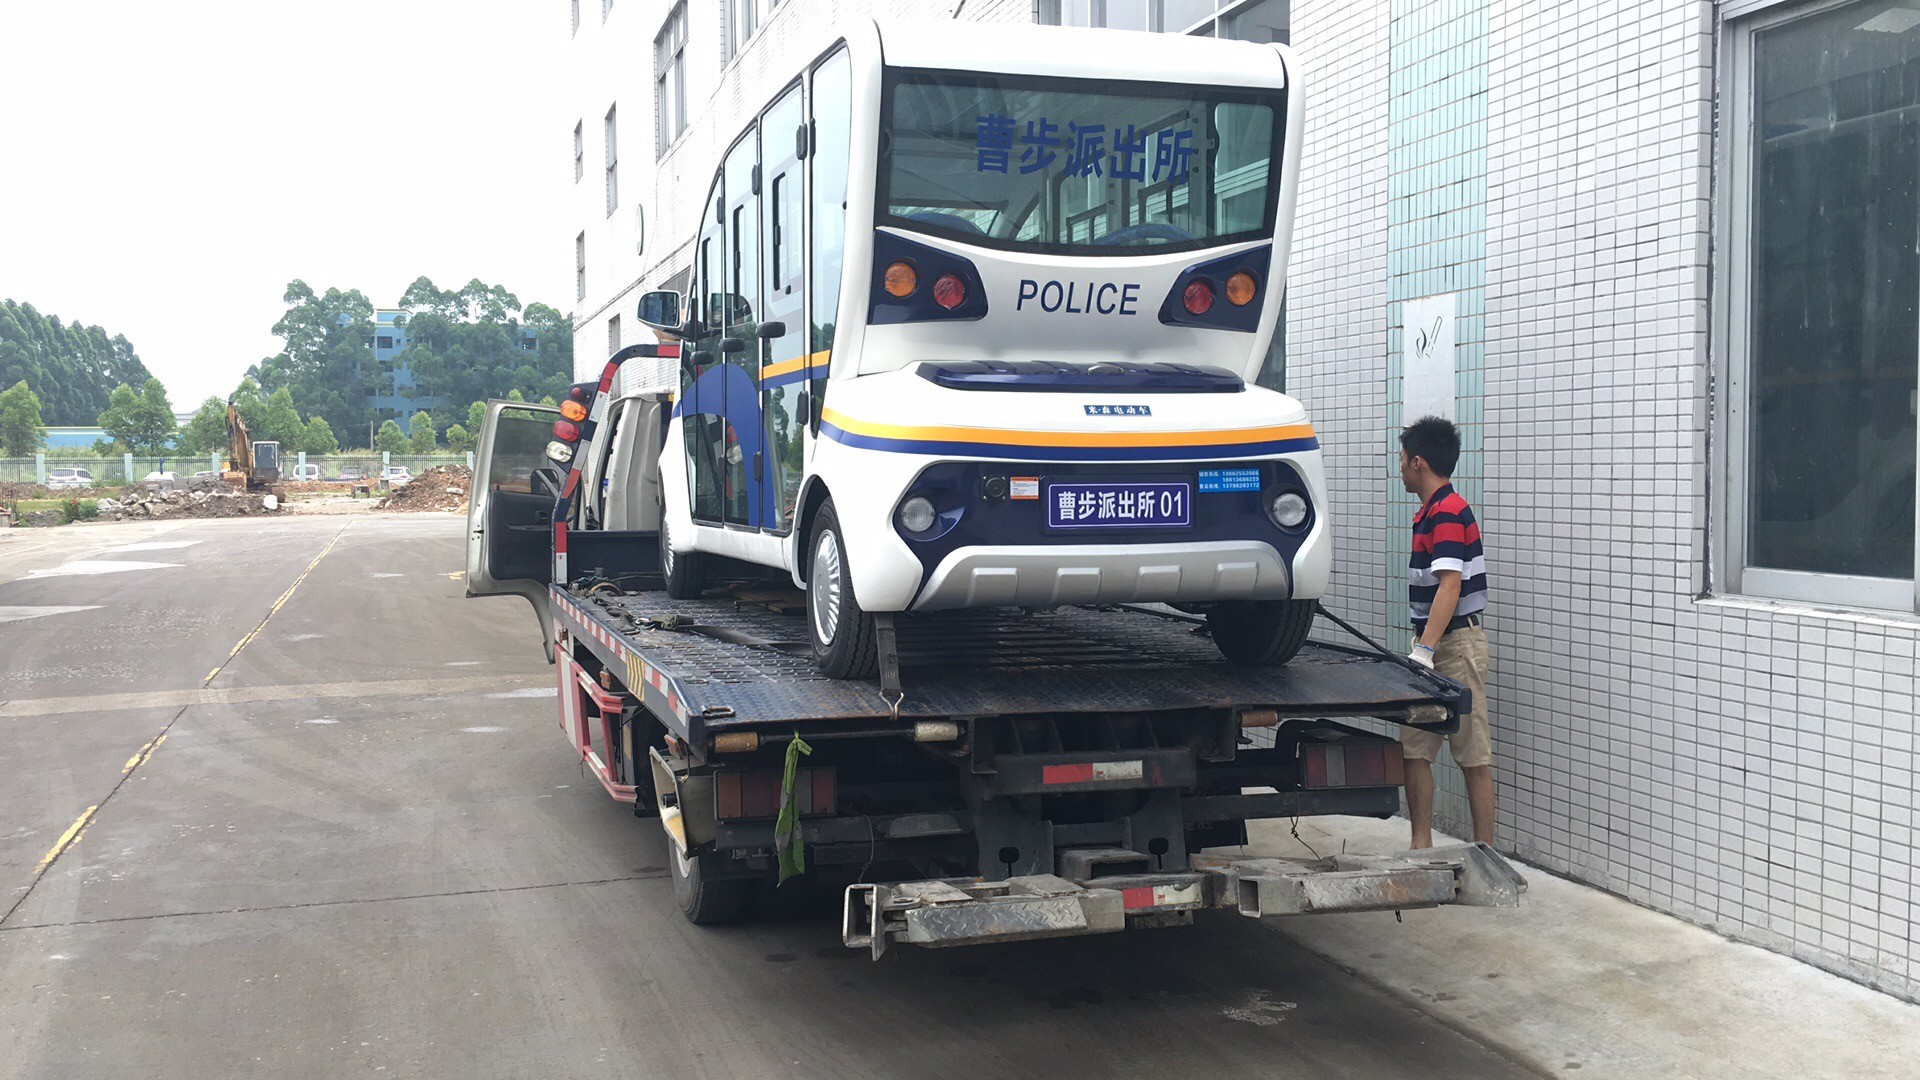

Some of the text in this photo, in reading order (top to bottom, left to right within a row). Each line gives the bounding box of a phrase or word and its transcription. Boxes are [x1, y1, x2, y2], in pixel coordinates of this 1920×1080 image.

[976, 113, 1194, 184] 曹步派出所
[1017, 279, 1140, 315] POLICE
[1058, 491, 1182, 520] 曹步派出所 01
